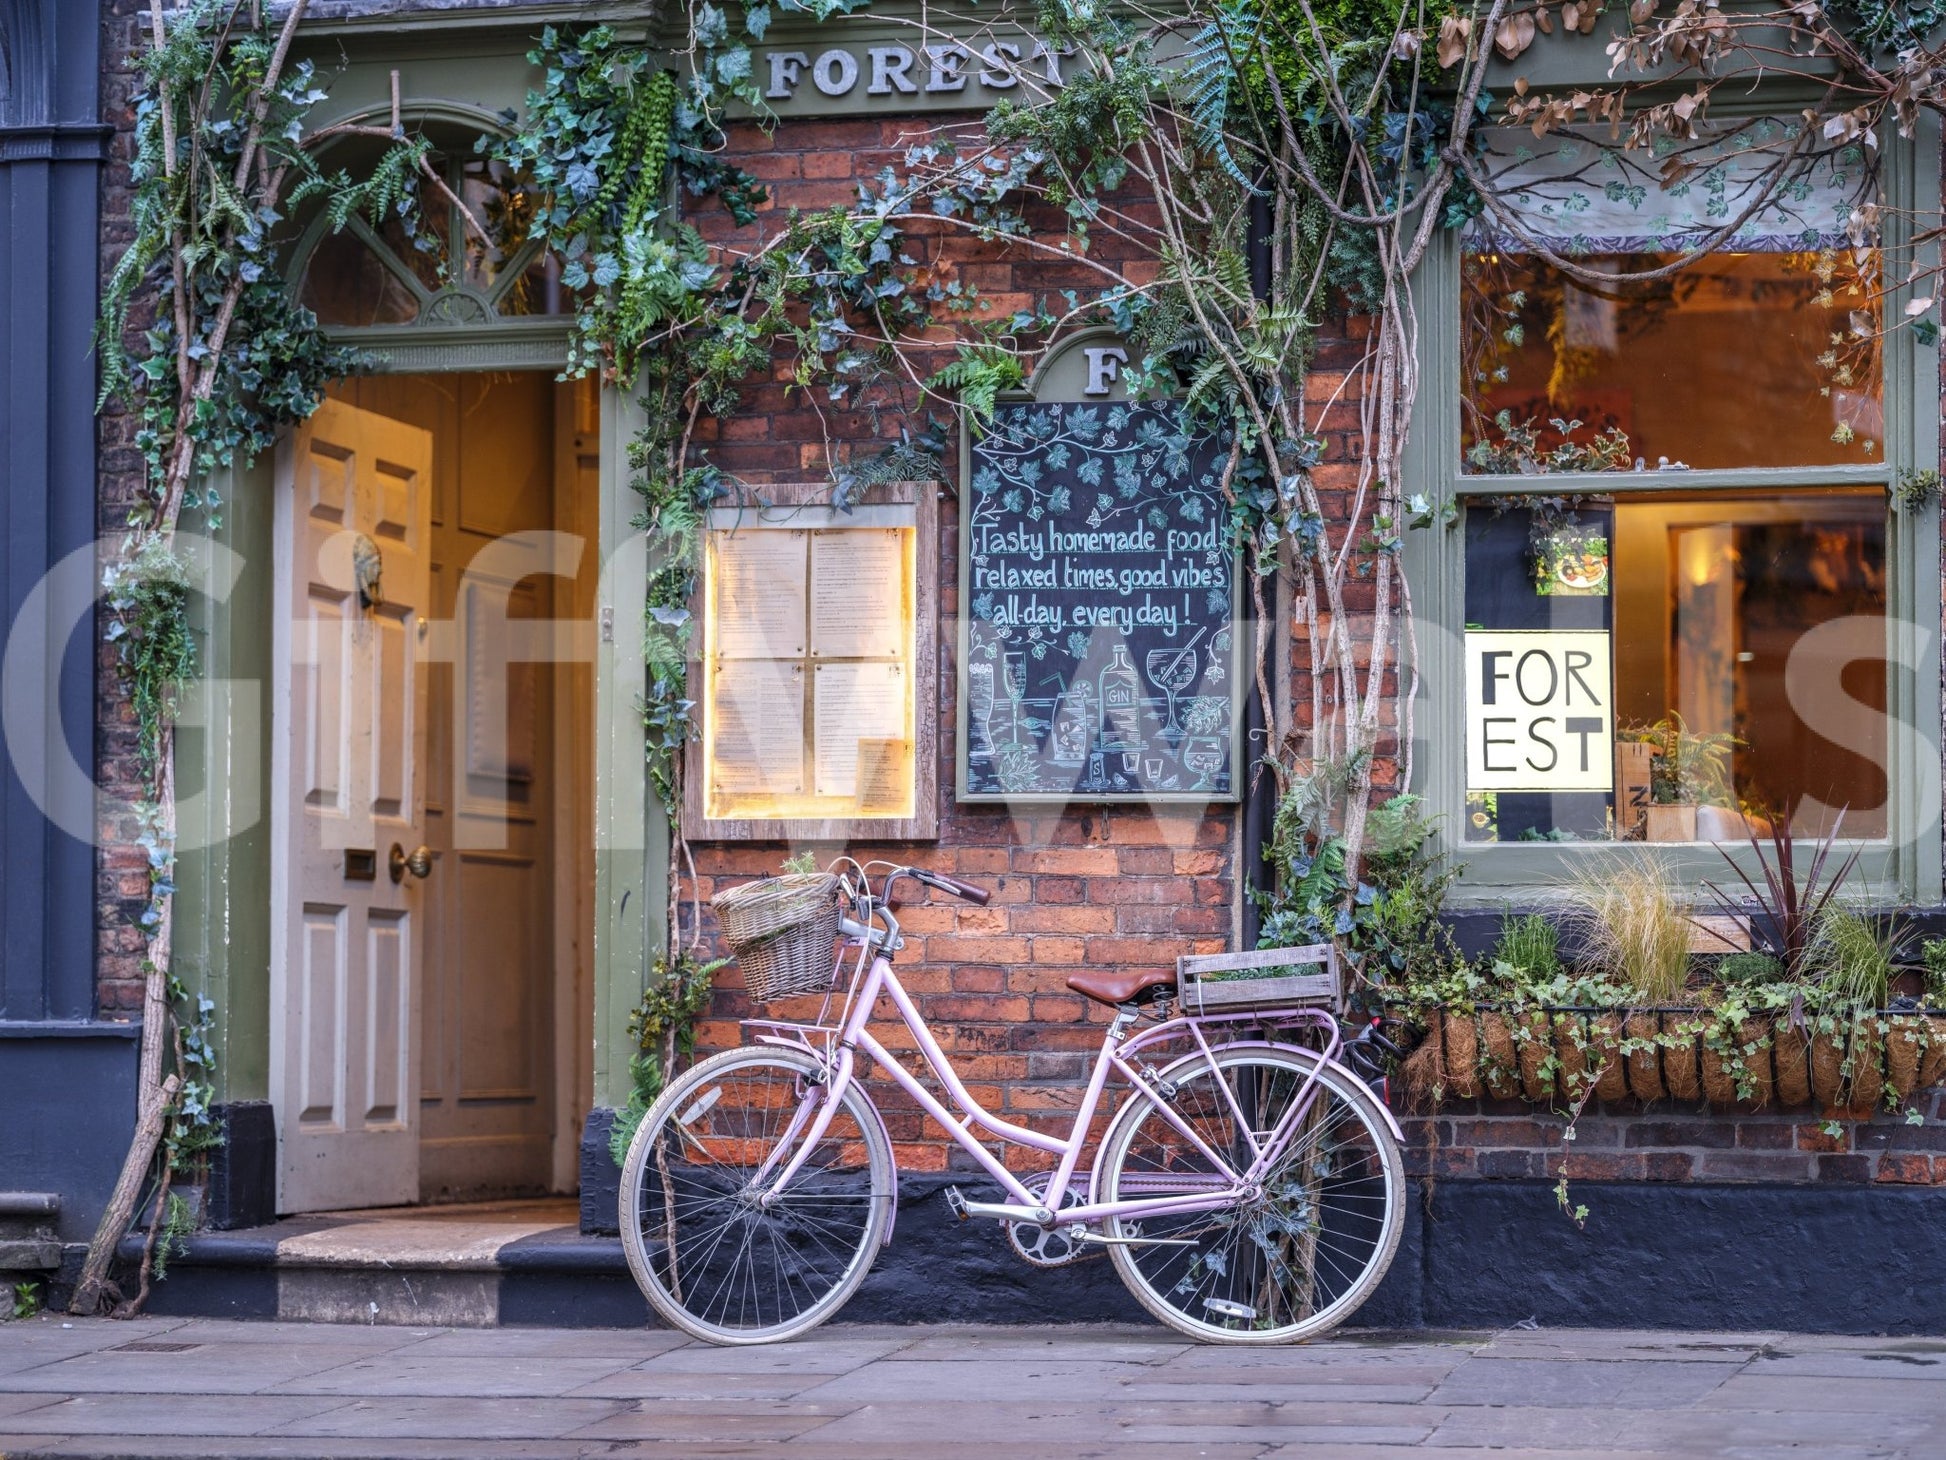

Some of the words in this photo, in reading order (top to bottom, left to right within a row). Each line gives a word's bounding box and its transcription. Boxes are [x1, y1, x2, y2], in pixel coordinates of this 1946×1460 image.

[765, 39, 1074, 98] FOREST
[1084, 347, 1129, 394] F
[973, 521, 1043, 560] Tasty
[1049, 518, 1156, 552] homemade
[975, 558, 1057, 588] relaxed
[1119, 559, 1167, 595] good
[1171, 557, 1225, 587] vibes
[1108, 689, 1129, 703] GIN
[1481, 649, 1602, 707] FOR
[1483, 716, 1603, 772] EST
